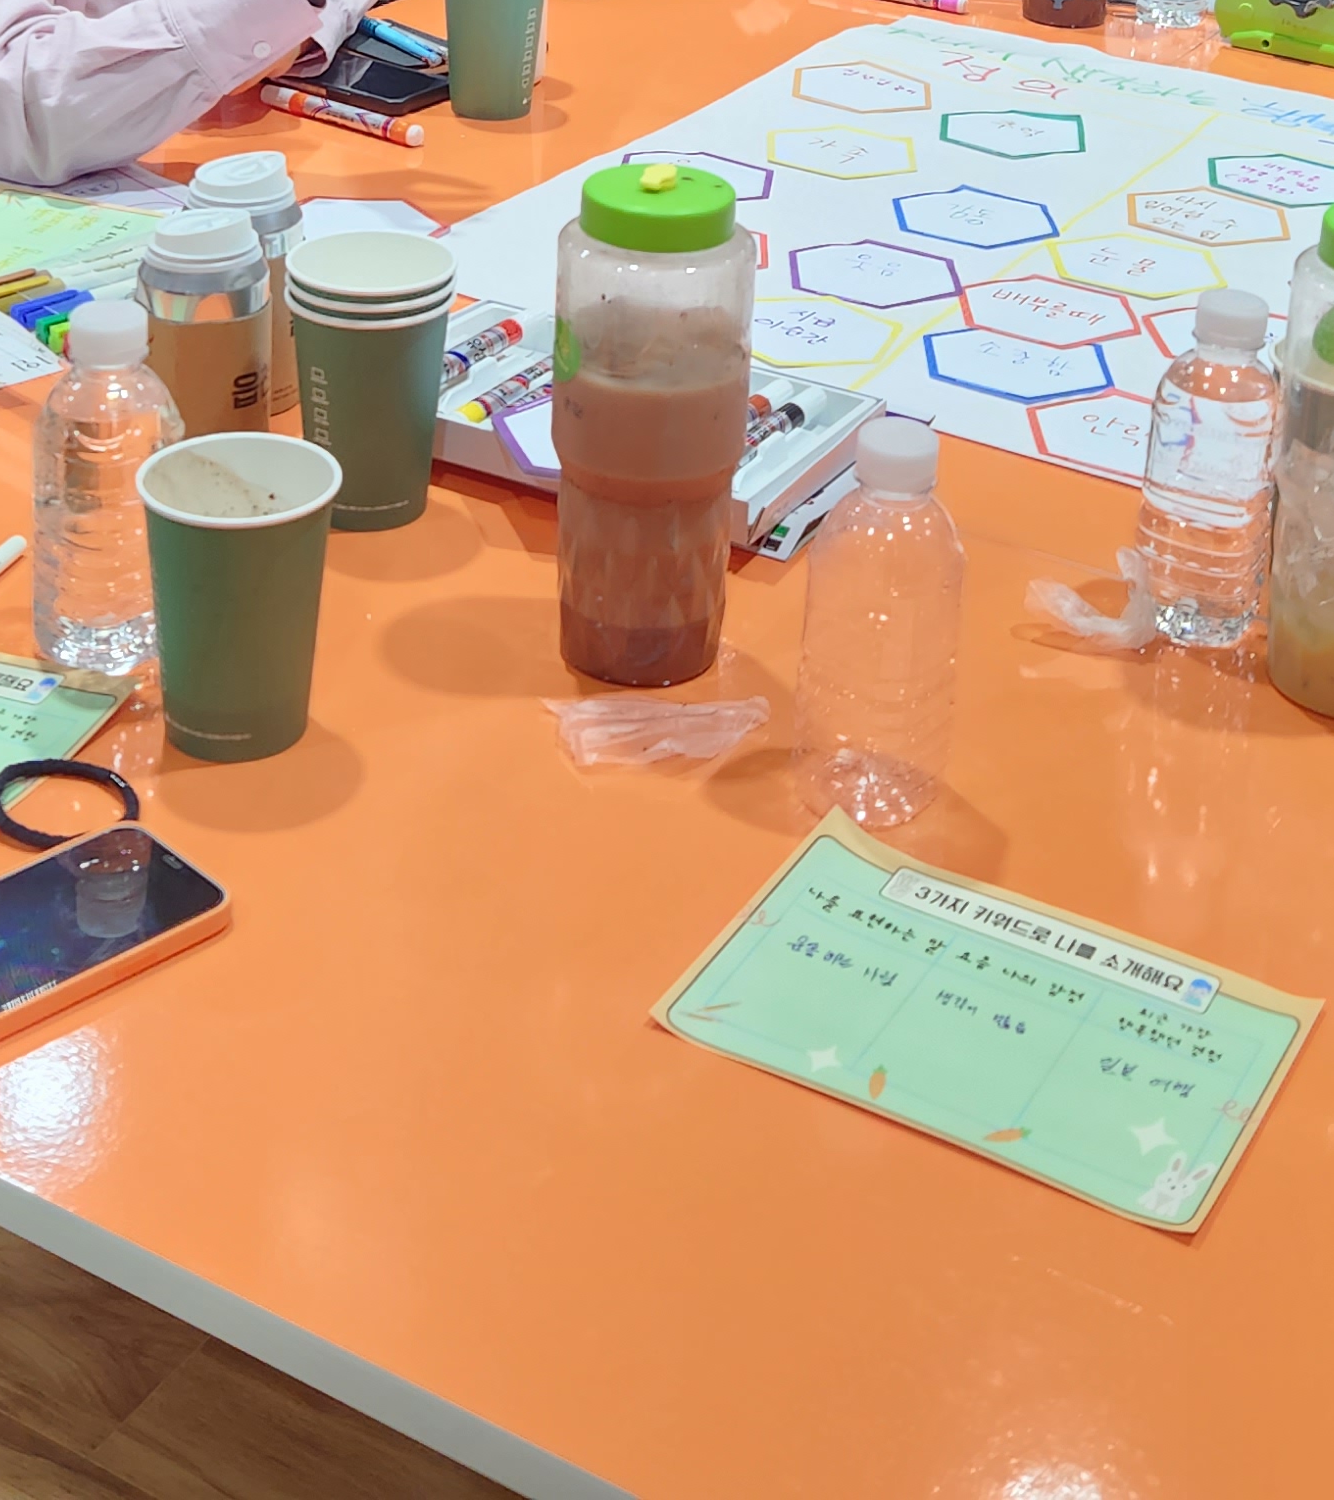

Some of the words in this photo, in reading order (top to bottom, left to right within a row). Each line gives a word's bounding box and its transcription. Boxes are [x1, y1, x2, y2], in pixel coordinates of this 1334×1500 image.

[807, 886, 840, 914] 나를
[914, 885, 970, 916] 3가지
[973, 905, 1052, 945] 키워드로
[1054, 933, 1098, 961] 나를
[1099, 953, 1185, 994] 소개해요
